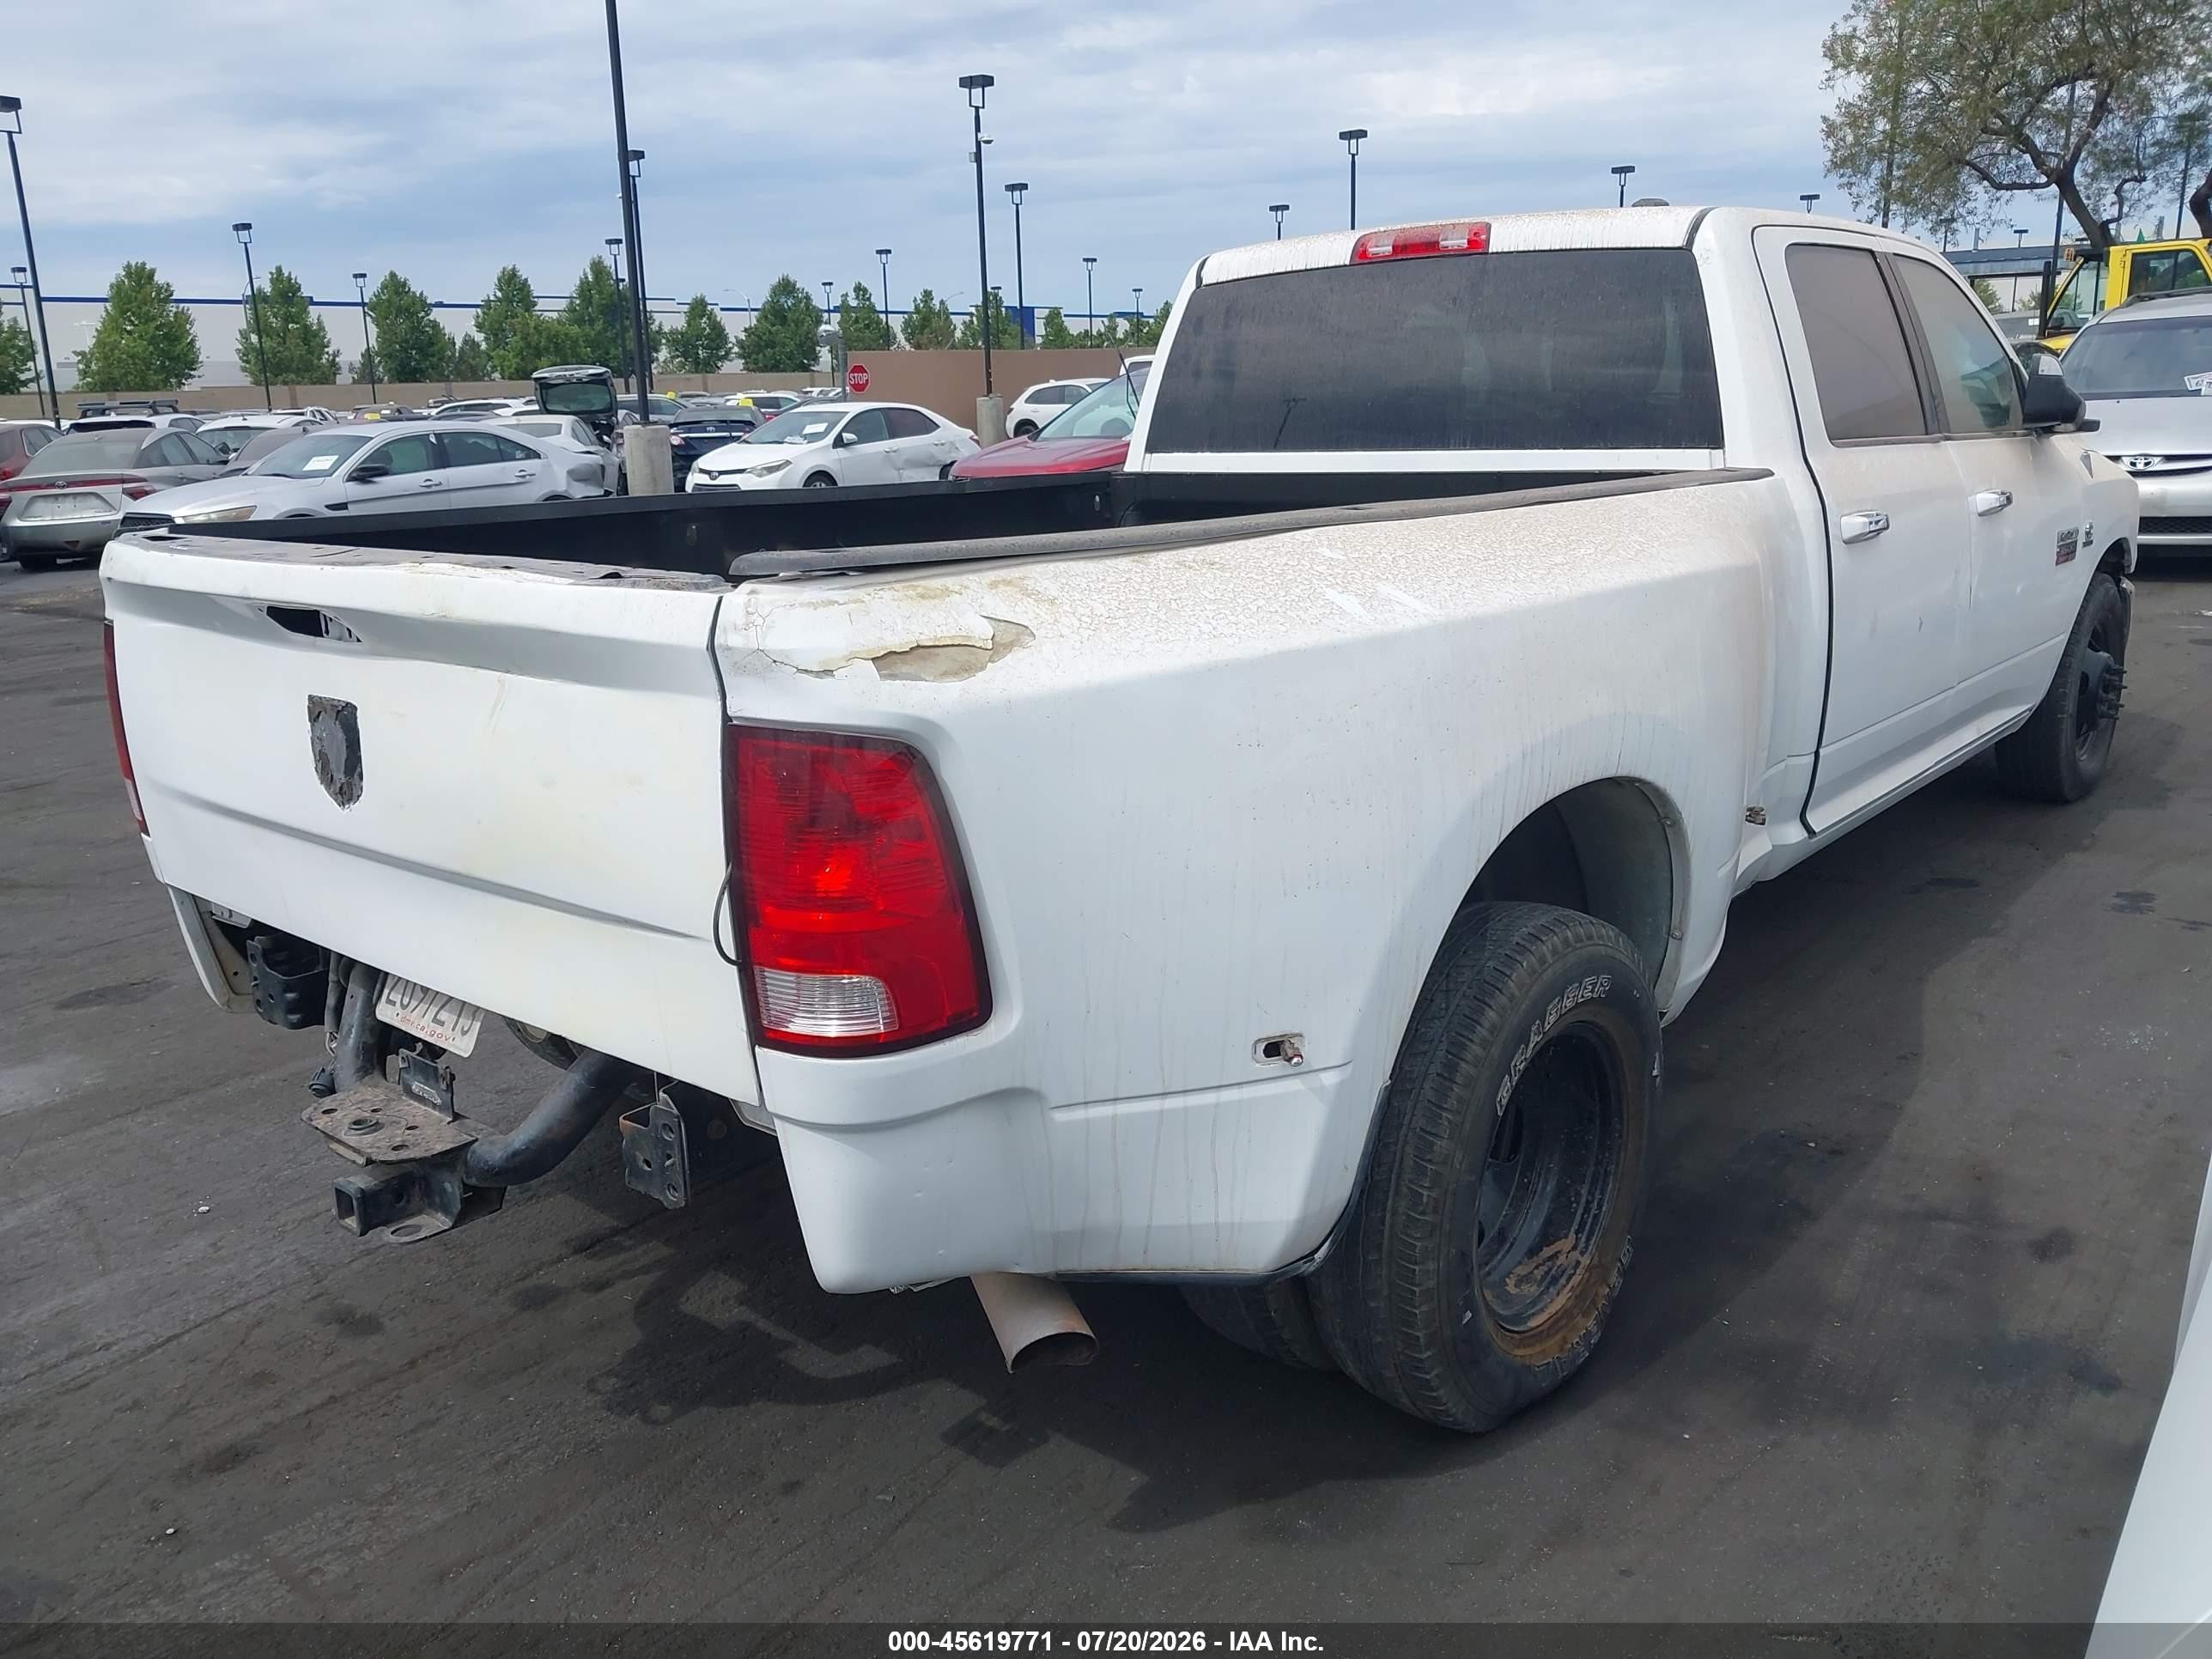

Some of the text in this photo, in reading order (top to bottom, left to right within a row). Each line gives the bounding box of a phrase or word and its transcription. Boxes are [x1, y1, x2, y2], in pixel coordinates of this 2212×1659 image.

[849, 373, 868, 385] STOP
[400, 1016, 452, 1042] dmv.ca.gov
[1496, 975, 1613, 1116] GRABBER
